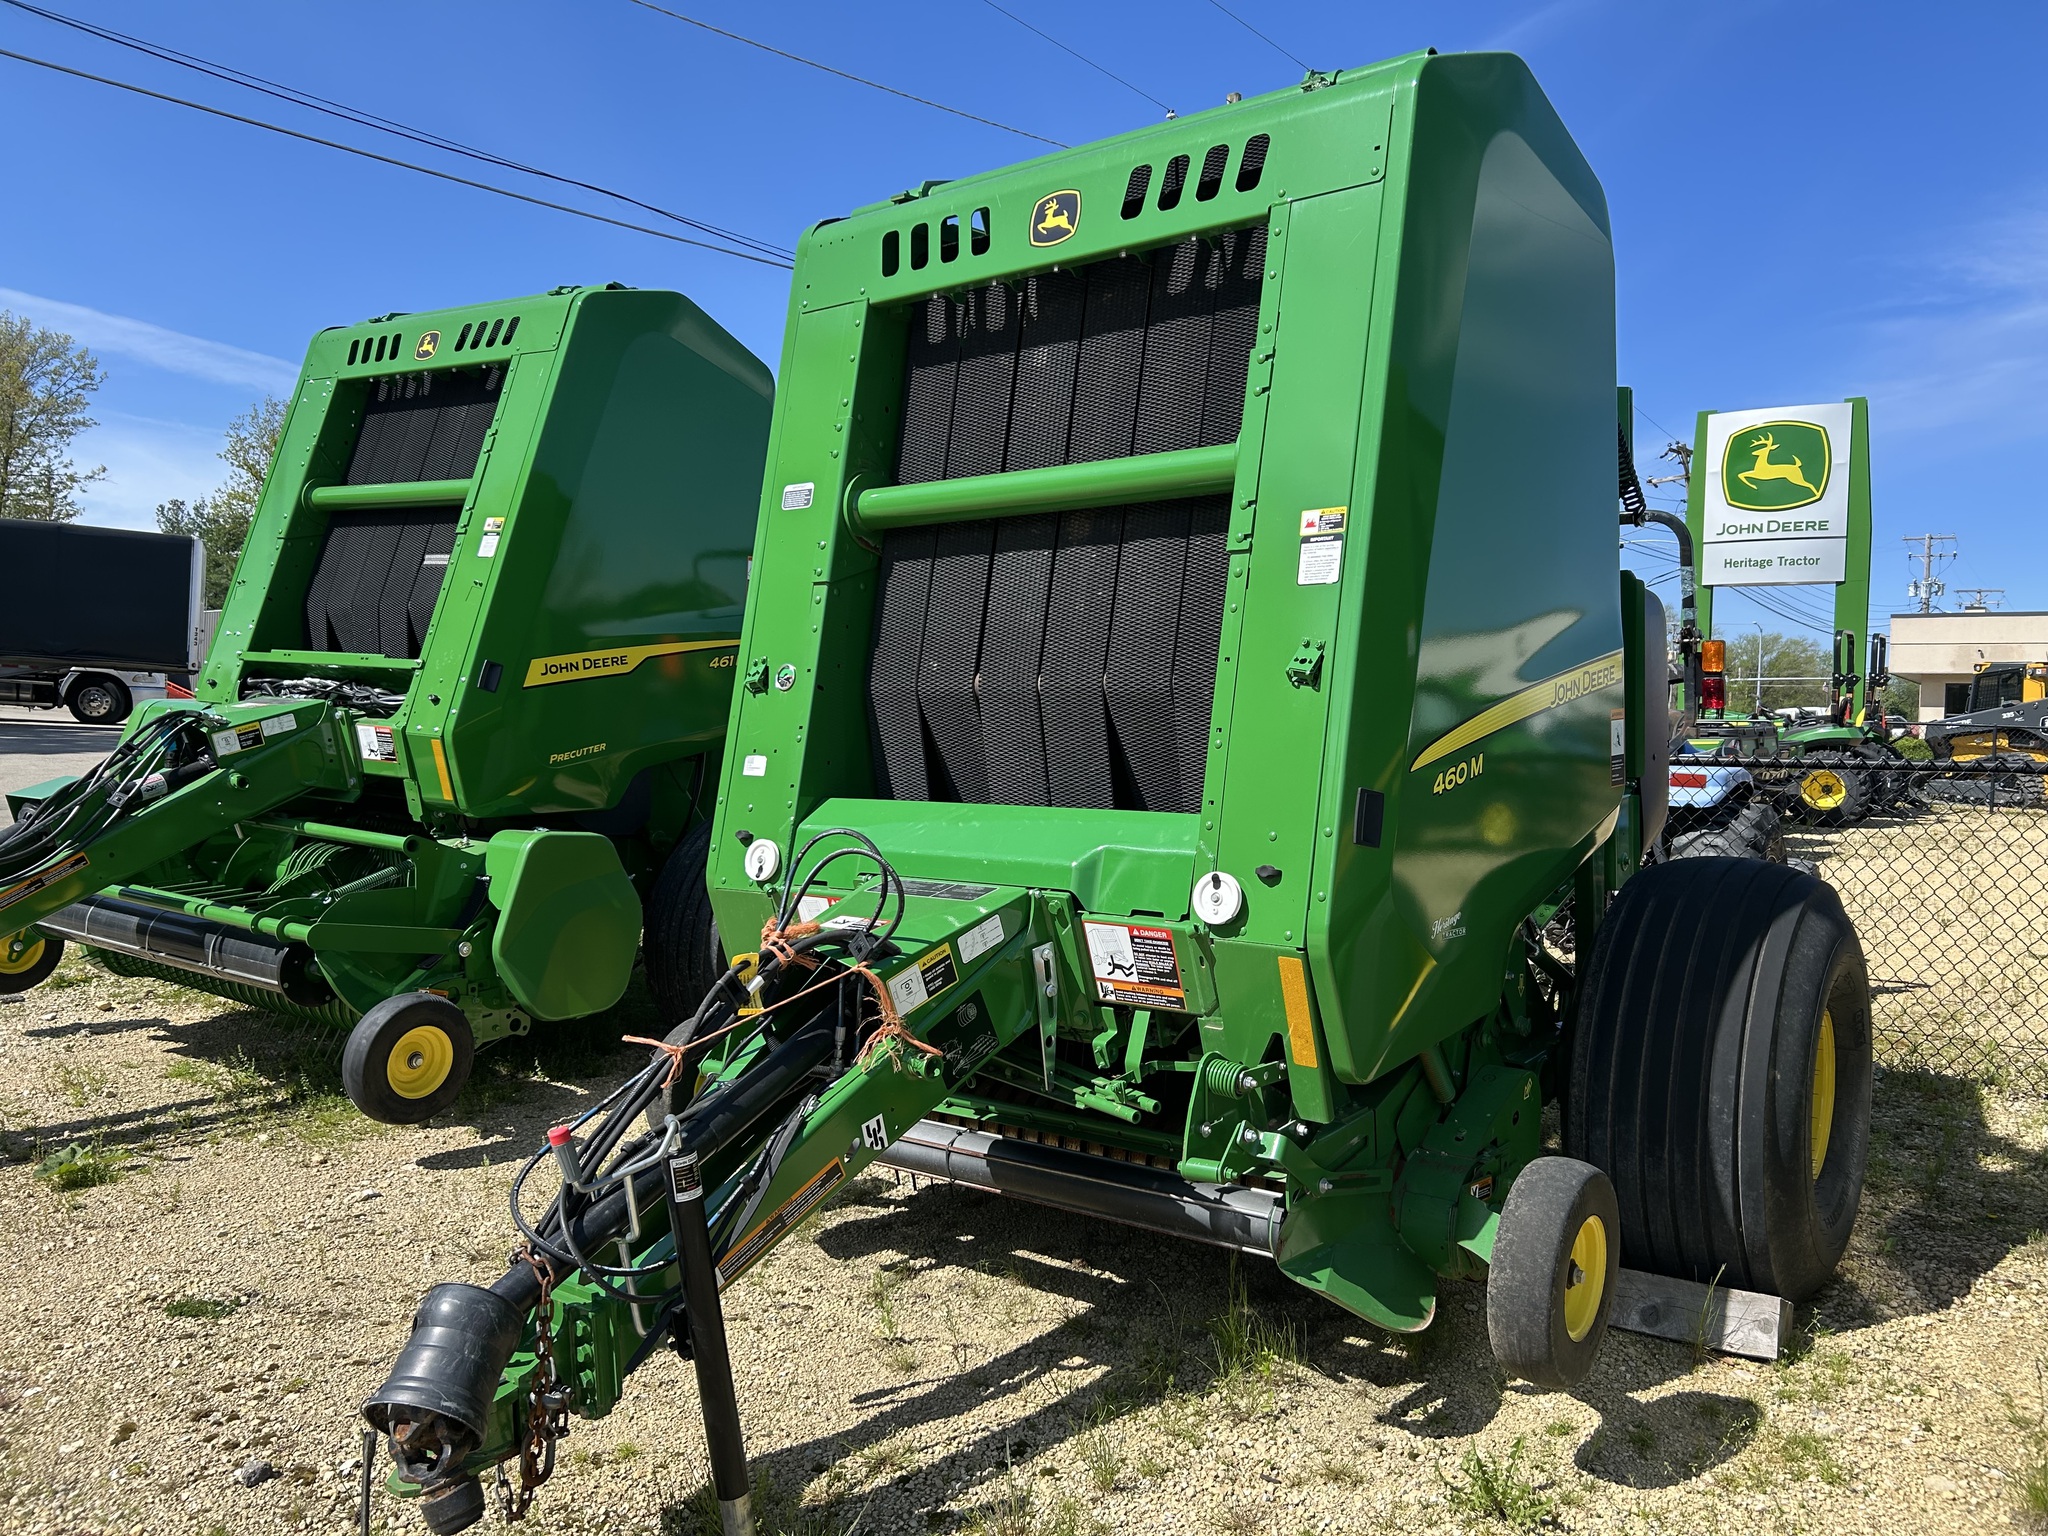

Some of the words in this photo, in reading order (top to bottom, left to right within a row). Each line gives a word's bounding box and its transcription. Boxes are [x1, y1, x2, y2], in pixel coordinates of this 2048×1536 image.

[1716, 522, 1764, 536] JOHN
[1767, 520, 1829, 533] DEERE
[1724, 556, 1773, 570] Heritage
[1777, 555, 1821, 567] Tractor
[540, 661, 579, 676] JOHN
[582, 655, 628, 670] DEERE
[709, 655, 735, 669] 461
[1550, 681, 1582, 706] JOHN
[1582, 664, 1616, 692] DEERE
[549, 742, 607, 764] PRECUTTER
[1432, 760, 1468, 796] 460
[1469, 753, 1485, 780] M
[1139, 929, 1168, 938] DANGER
[926, 948, 947, 964] CAUTION
[1135, 985, 1165, 995] WARNING
[769, 1197, 794, 1223] WARNING
